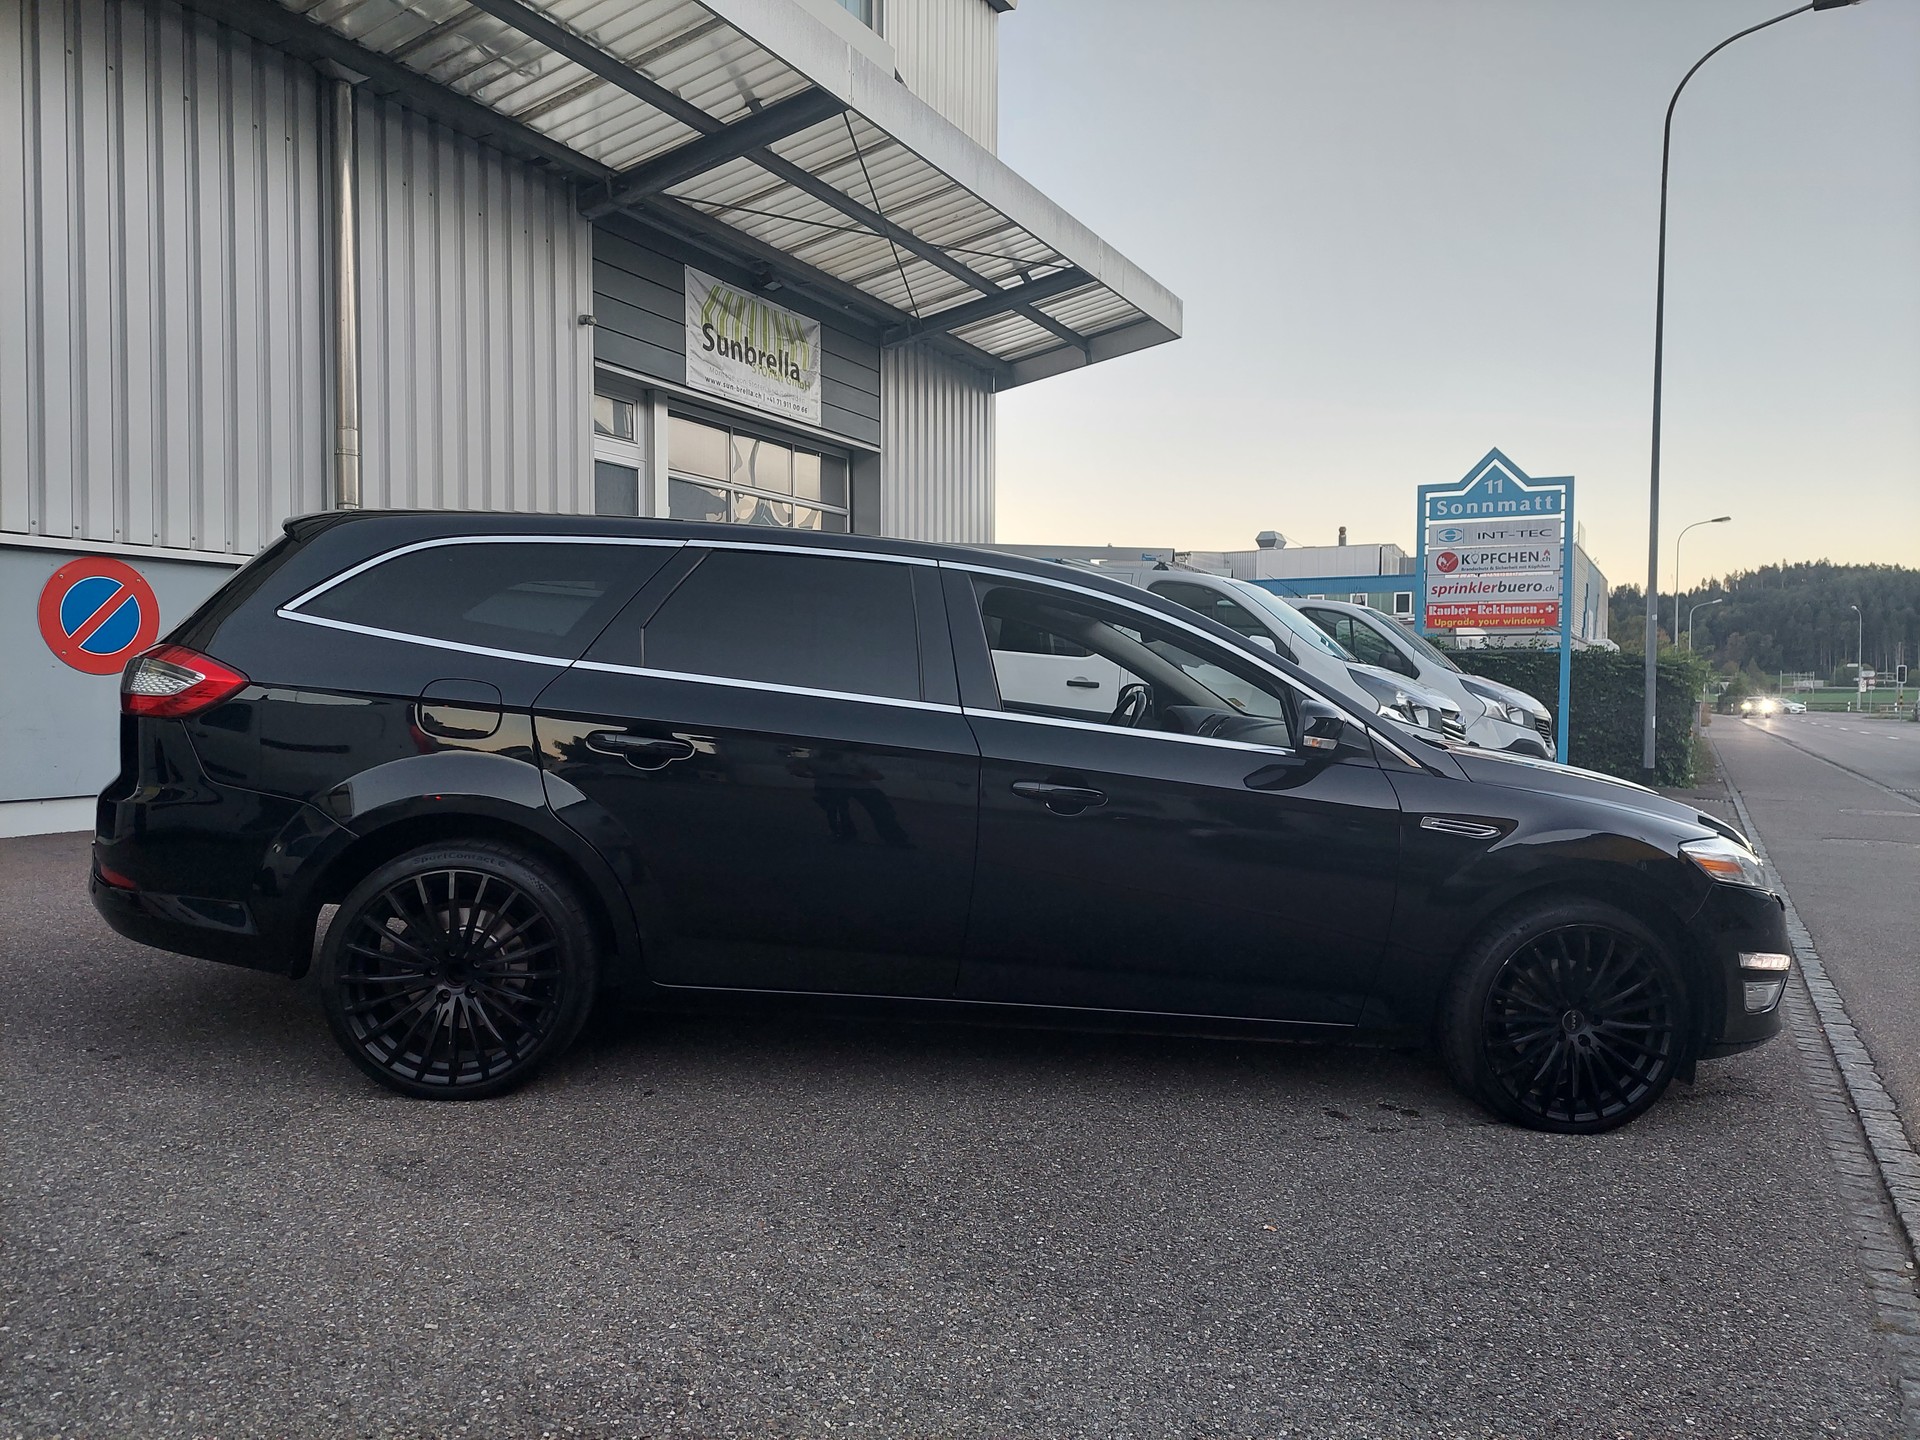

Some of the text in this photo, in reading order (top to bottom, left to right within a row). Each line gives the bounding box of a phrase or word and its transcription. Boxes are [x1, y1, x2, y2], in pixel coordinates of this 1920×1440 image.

[702, 323, 800, 382] Sunbrella
[786, 376, 810, 391] GmbH
[777, 398, 782, 406] 71
[793, 403, 800, 412] 00
[801, 405, 808, 414] 66
[1484, 479, 1503, 494] 11
[1437, 496, 1552, 515] Sonnmatt
[1477, 529, 1552, 540] INT-TEC
[1431, 581, 1554, 597] sprinklerbuero.ch
[1434, 618, 1474, 627] Upgrade
[1503, 617, 1545, 625] windows
